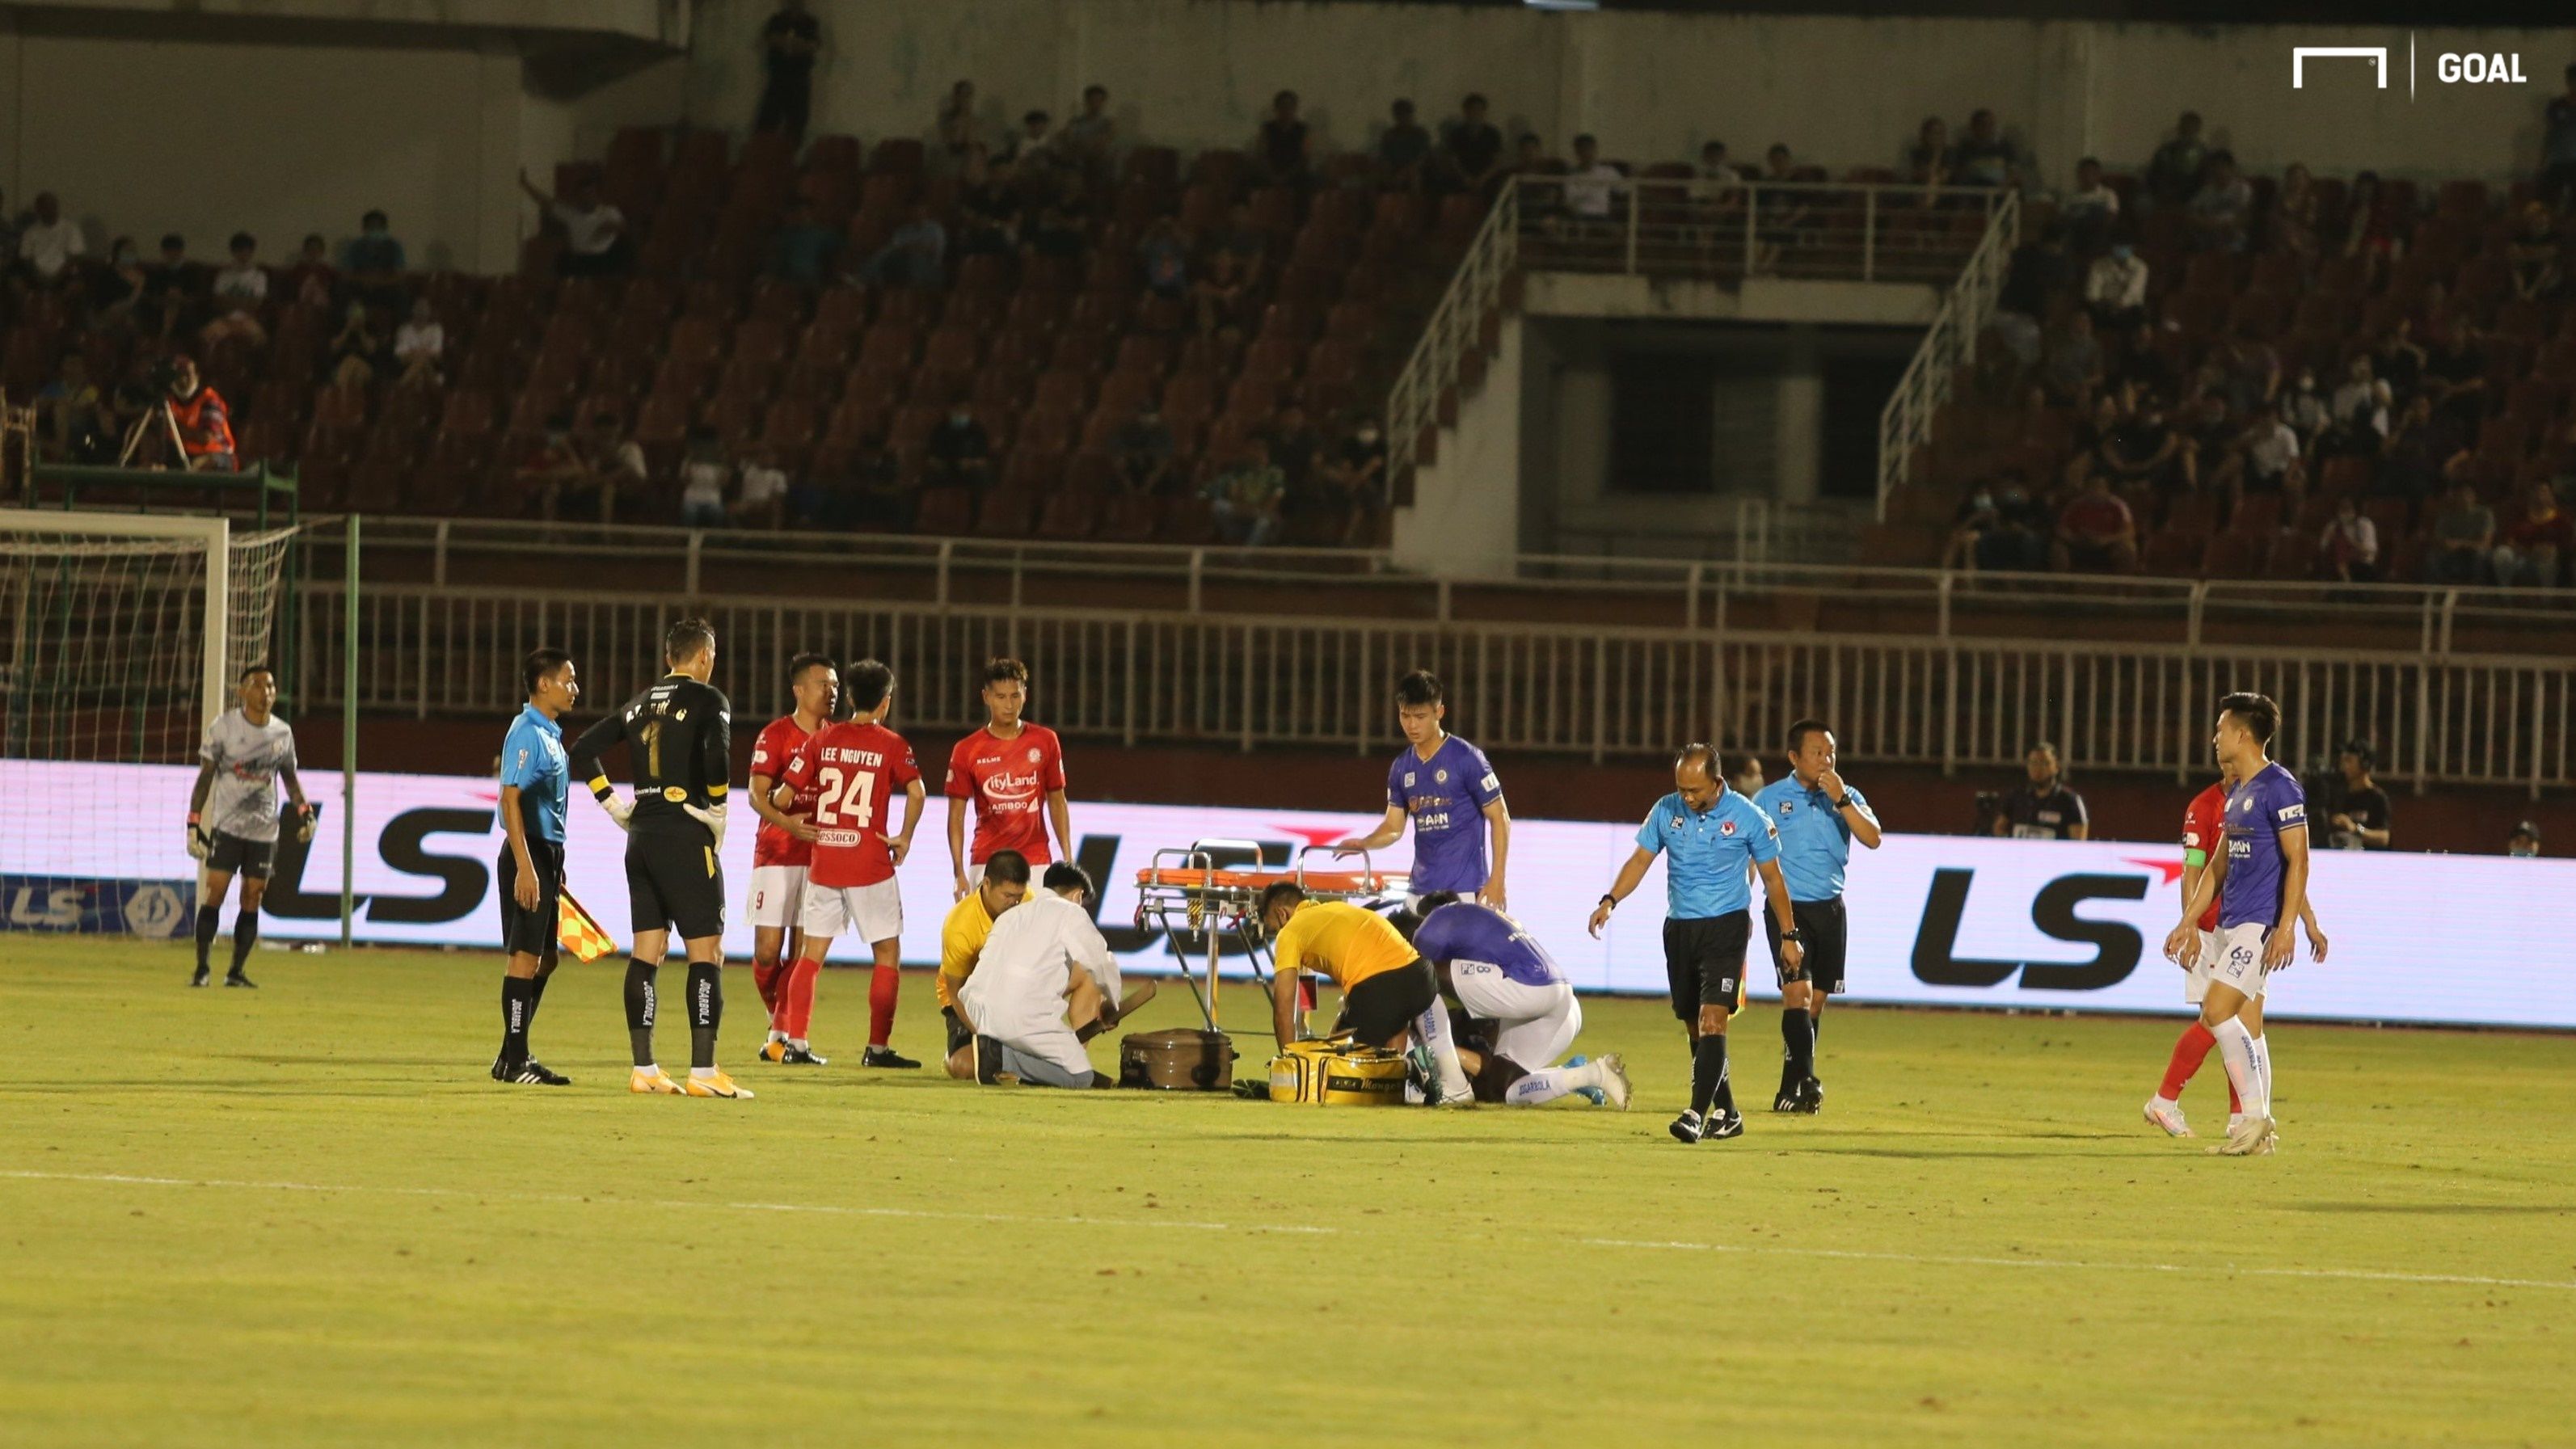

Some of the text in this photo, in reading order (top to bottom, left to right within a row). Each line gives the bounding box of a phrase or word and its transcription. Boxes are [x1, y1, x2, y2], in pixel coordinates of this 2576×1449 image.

[820, 748, 883, 768] LEE NGUYEN
[817, 767, 875, 828] 24
[260, 802, 495, 924] LS
[11, 887, 86, 925] LS
[756, 891, 764, 910] 9
[1911, 867, 2150, 991] LS
[1476, 965, 1491, 973] 8
[2230, 946, 2253, 965] 68
[698, 978, 711, 1026] JOGARBOLA
